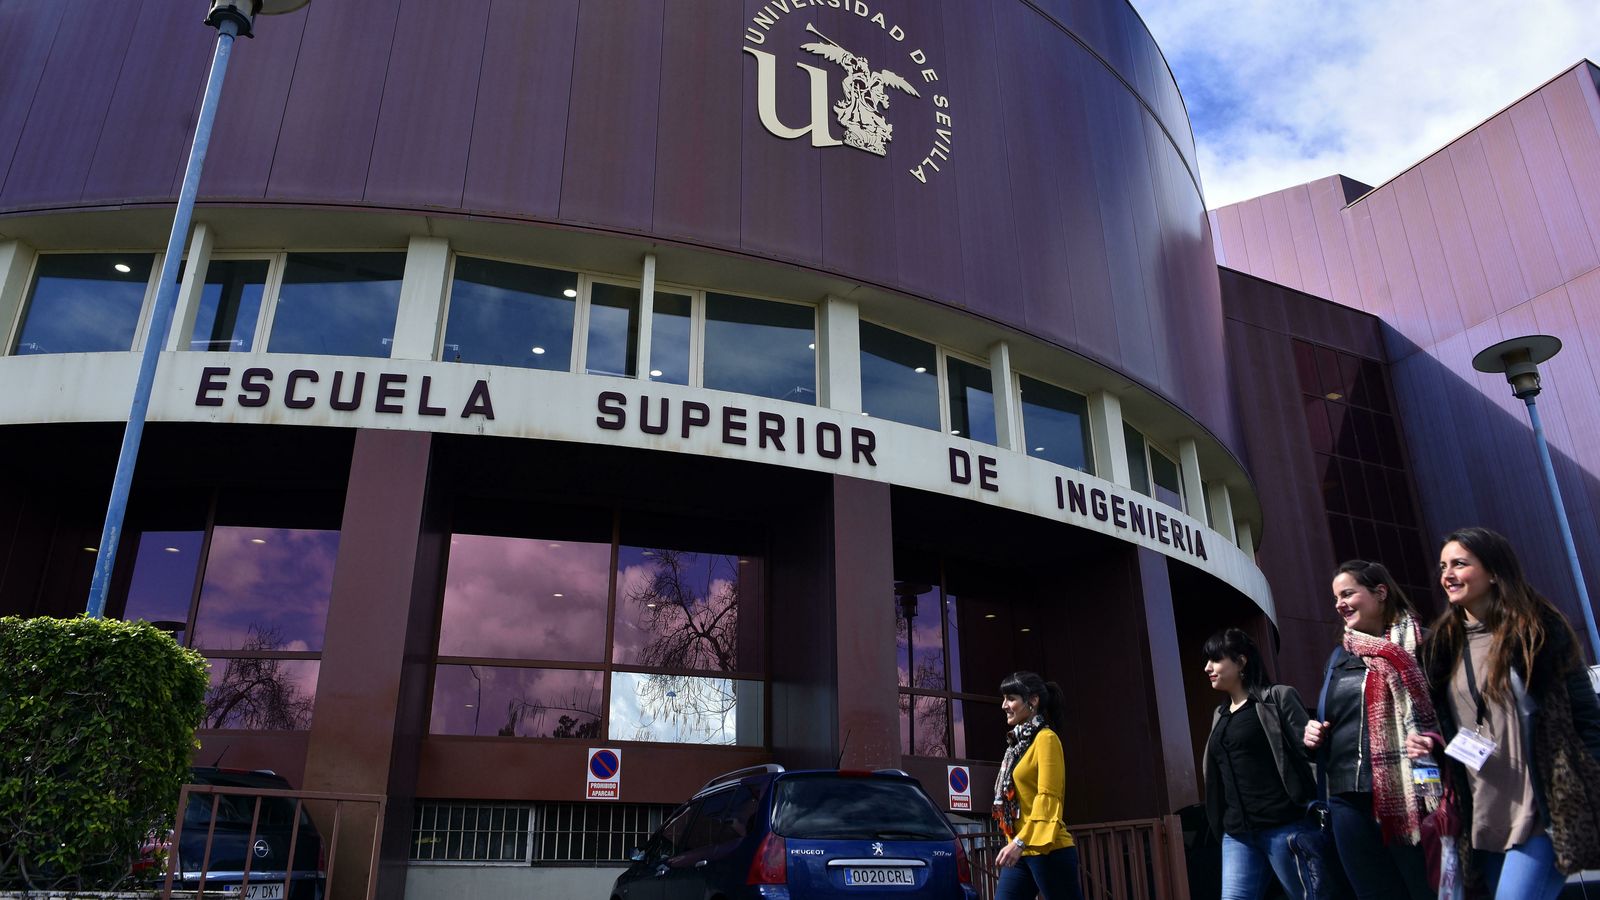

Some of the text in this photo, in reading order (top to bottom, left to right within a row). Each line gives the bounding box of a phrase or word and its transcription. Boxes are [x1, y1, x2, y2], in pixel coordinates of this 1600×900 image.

[909, 48, 939, 83] DE
[909, 94, 952, 184] SEVILLA
[195, 366, 1208, 561] ESCUELA SUPERIOR DE INGENIERIA
[262, 885, 280, 899] DXY
[853, 870, 911, 883] 0020 CRL
